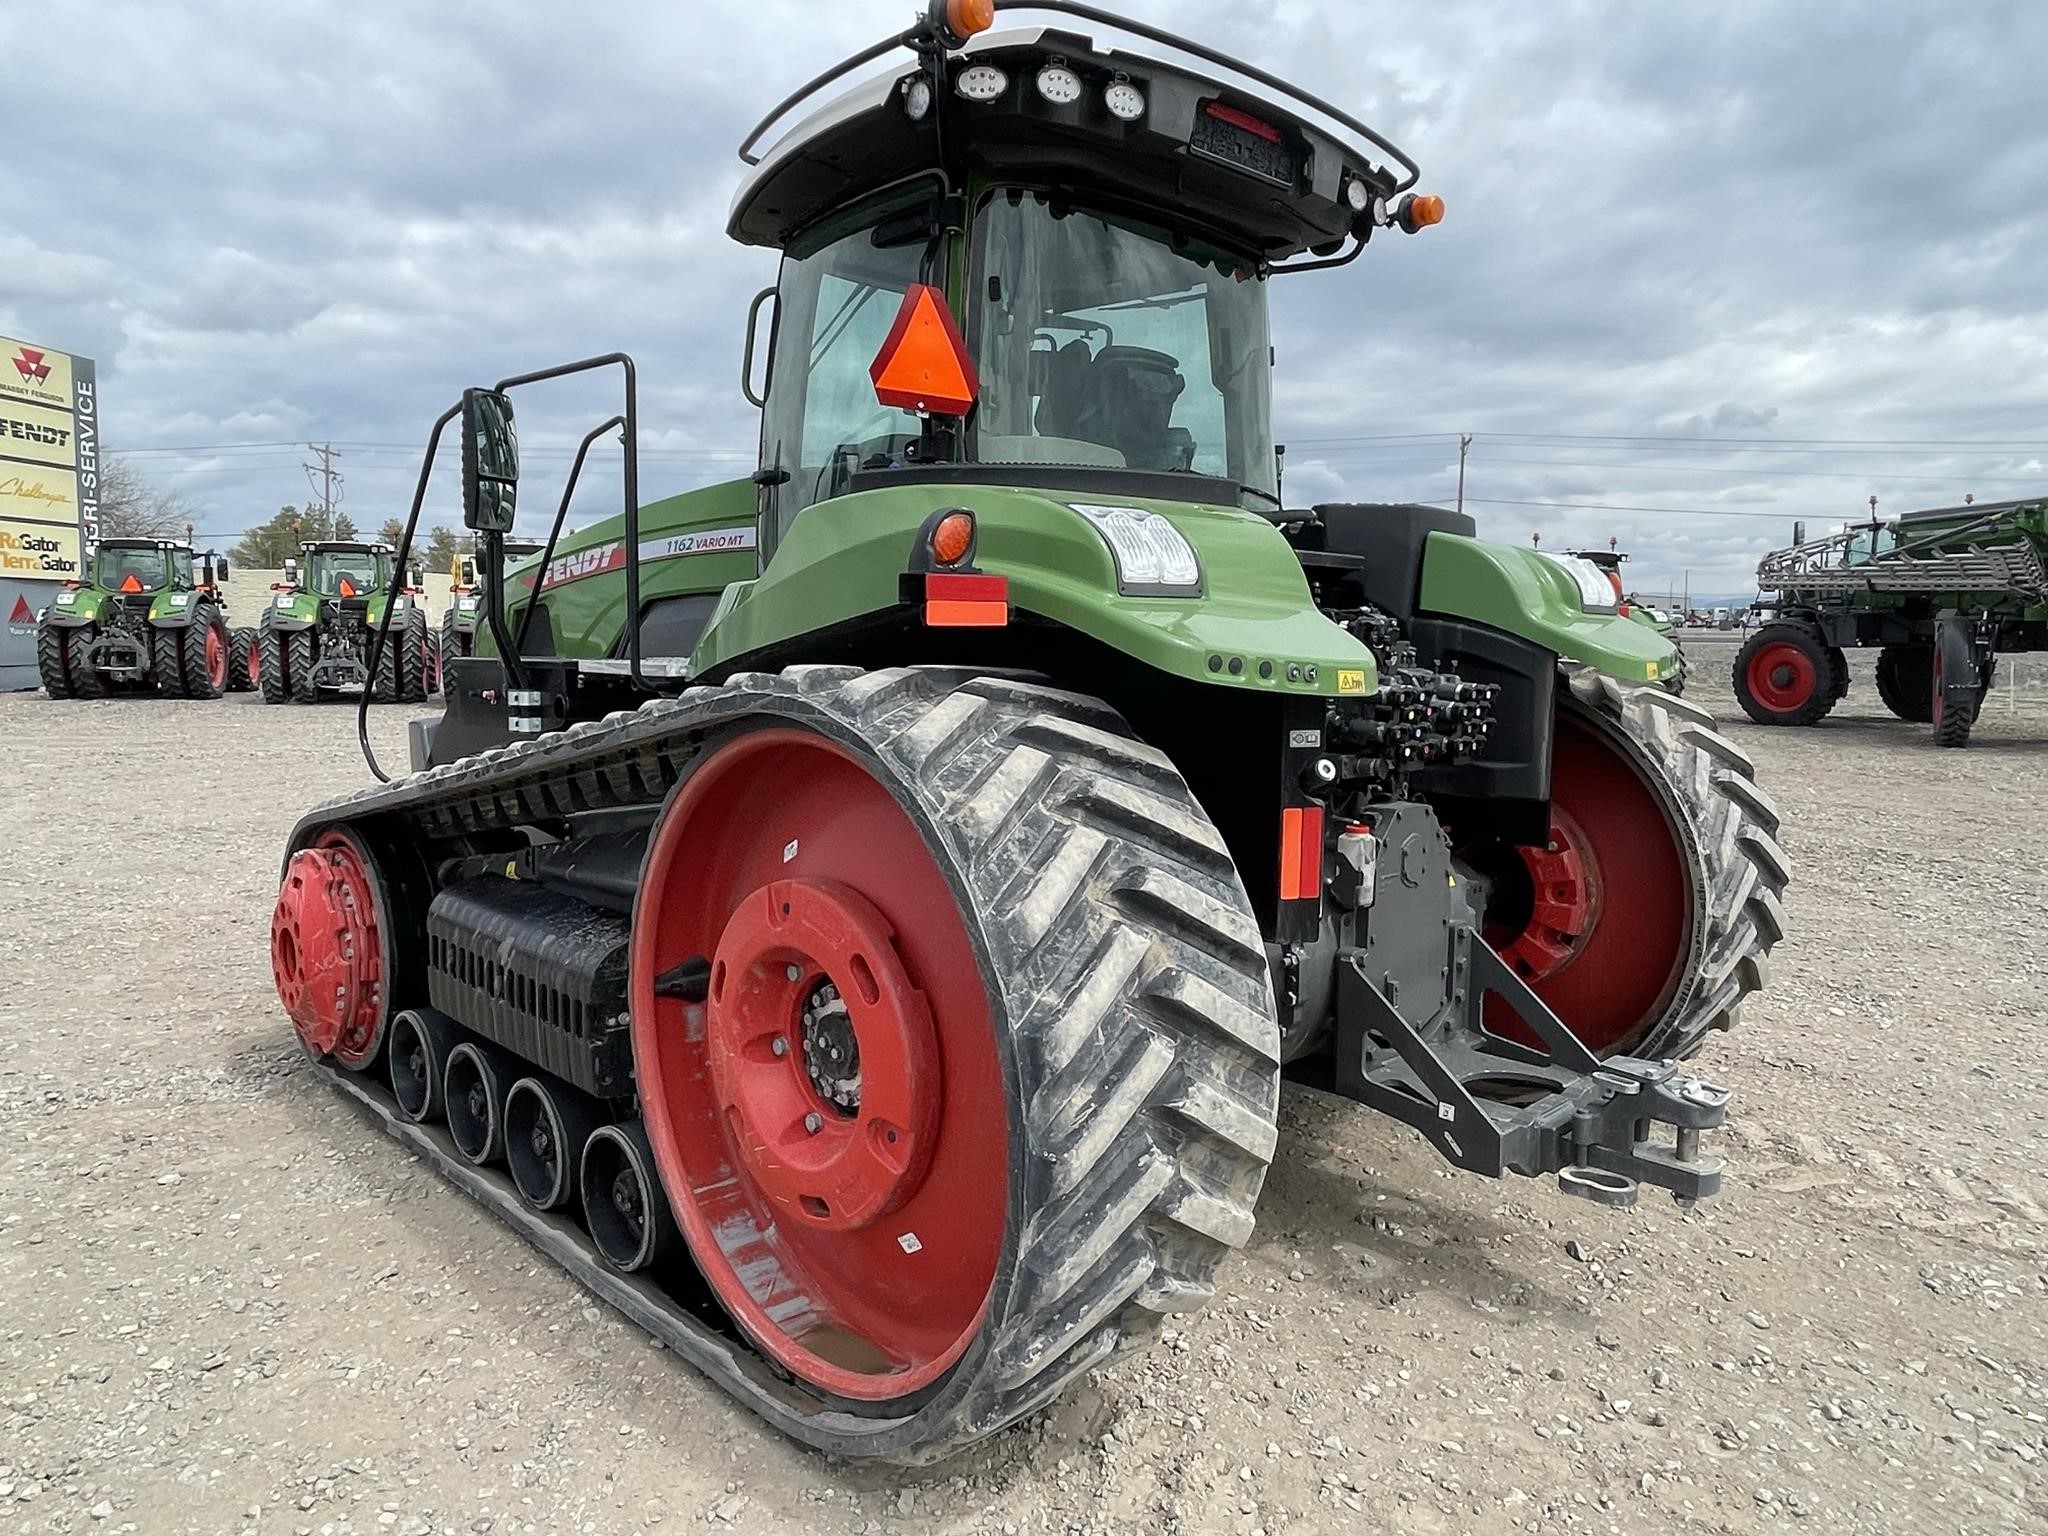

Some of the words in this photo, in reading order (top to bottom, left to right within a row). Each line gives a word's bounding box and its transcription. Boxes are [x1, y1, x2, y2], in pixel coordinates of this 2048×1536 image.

[31, 389, 65, 403] FERGUSON
[666, 537, 694, 554] 1162
[696, 536, 726, 549] VARIO
[727, 534, 744, 546] MT
[542, 542, 619, 586] FENDT
